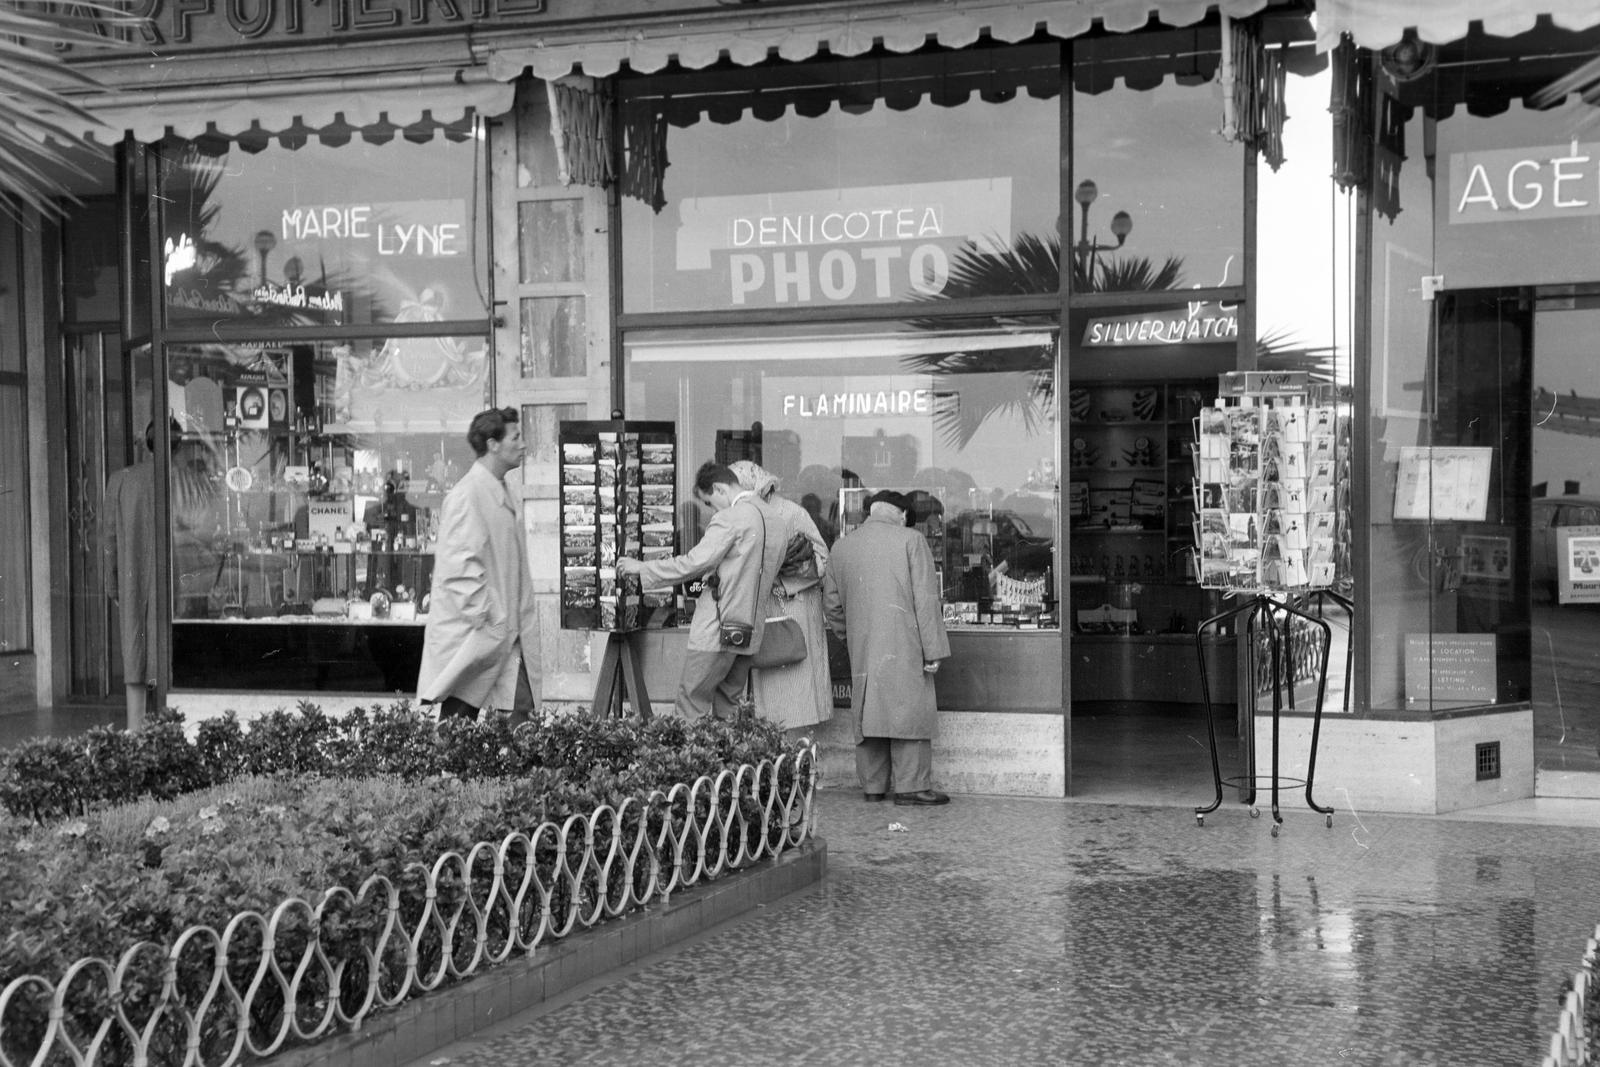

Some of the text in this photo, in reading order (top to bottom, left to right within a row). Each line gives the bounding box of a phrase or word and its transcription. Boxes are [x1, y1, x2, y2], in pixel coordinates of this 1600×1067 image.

[282, 205, 372, 241] MARIE
[733, 206, 942, 246] DENICOTEA
[377, 222, 461, 257] LYNE
[730, 244, 948, 304] PHOTO
[1090, 316, 1238, 344] SILVERMATCH
[783, 389, 928, 417] FLAMINAIRE
[311, 507, 348, 515] CHANEL
[1573, 582, 1600, 590] Maur
